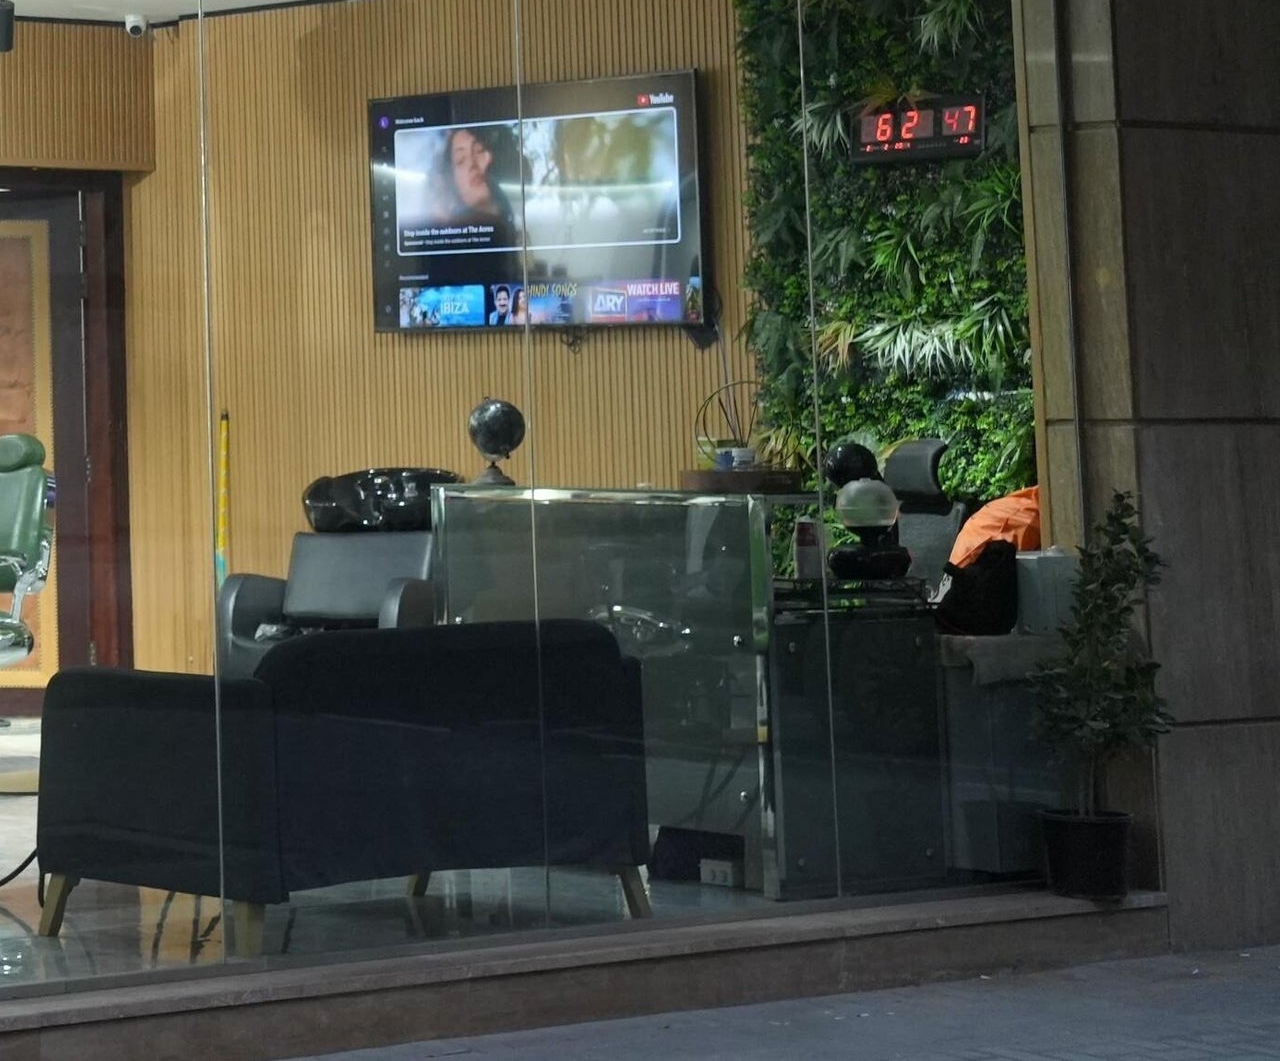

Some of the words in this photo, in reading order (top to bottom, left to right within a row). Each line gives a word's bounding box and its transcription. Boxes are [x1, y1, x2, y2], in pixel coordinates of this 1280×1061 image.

[944, 105, 976, 132] 47
[627, 283, 659, 297] WATCH
[660, 282, 680, 296] LIVE
[593, 293, 625, 313] ARY
